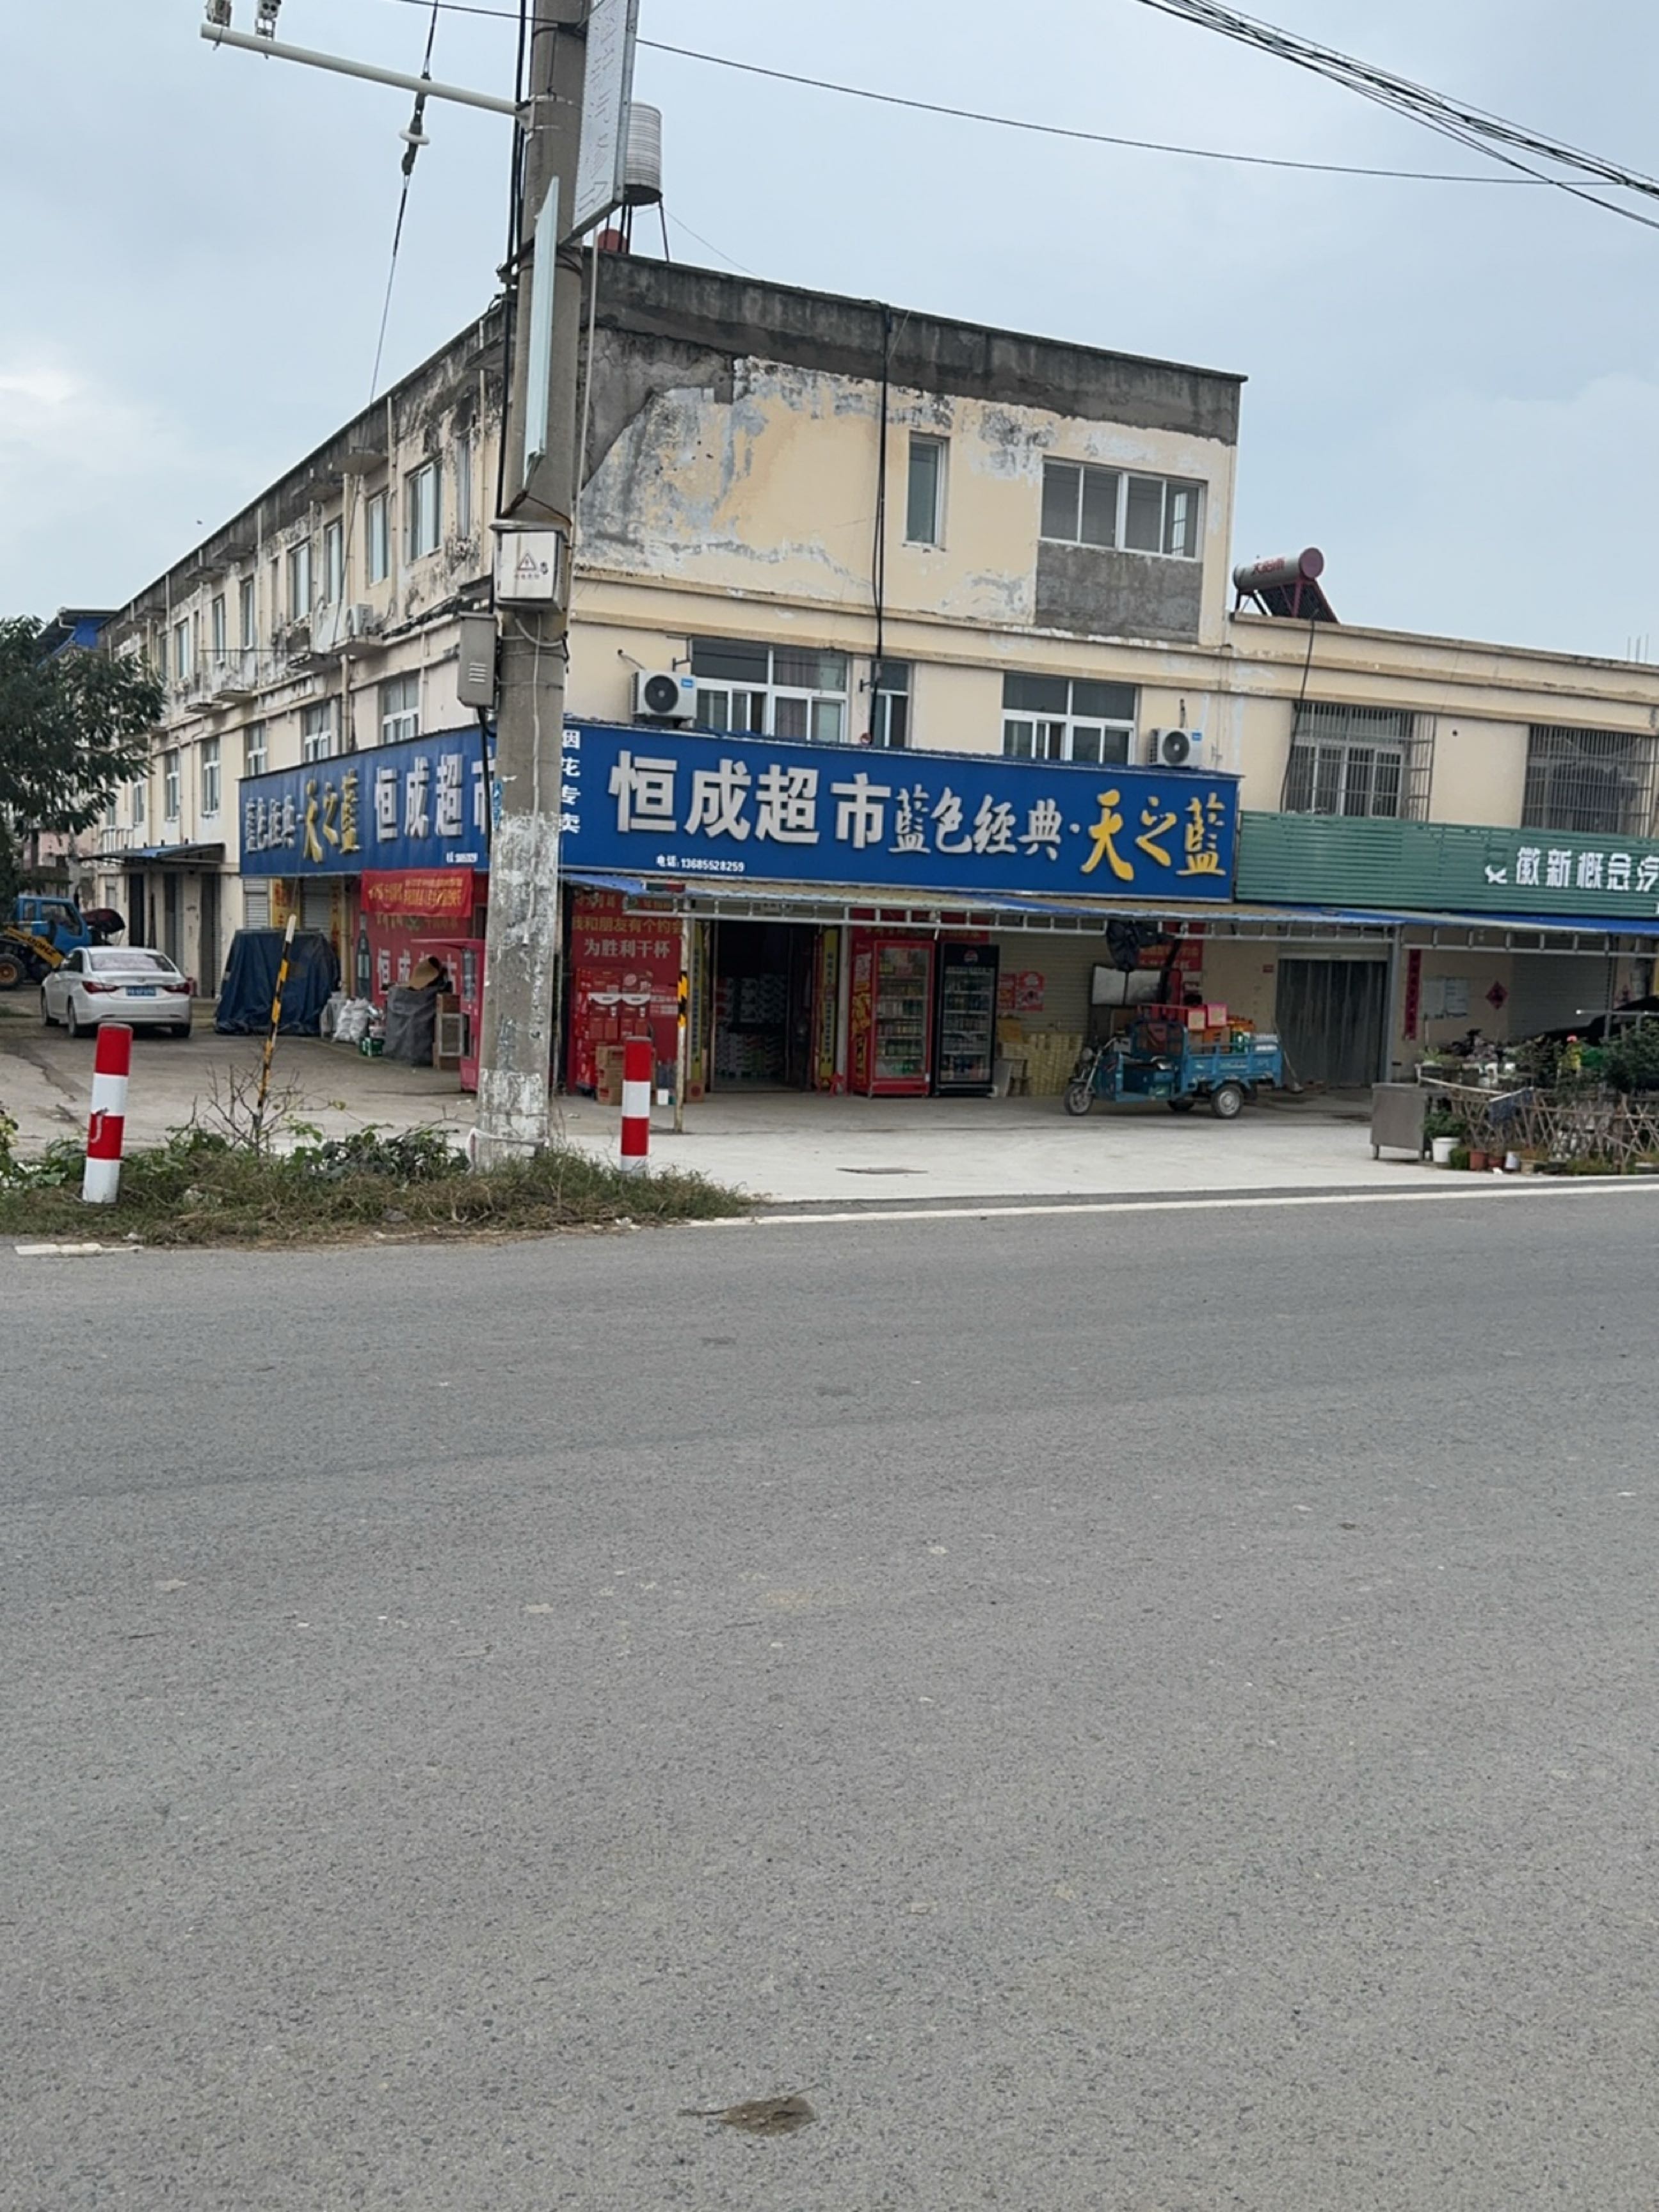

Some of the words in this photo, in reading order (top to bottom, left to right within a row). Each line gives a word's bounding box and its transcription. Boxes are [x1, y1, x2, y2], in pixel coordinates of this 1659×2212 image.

[609, 750, 892, 850] 恒成超市
[584, 938, 671, 959] 为胜利干杯
